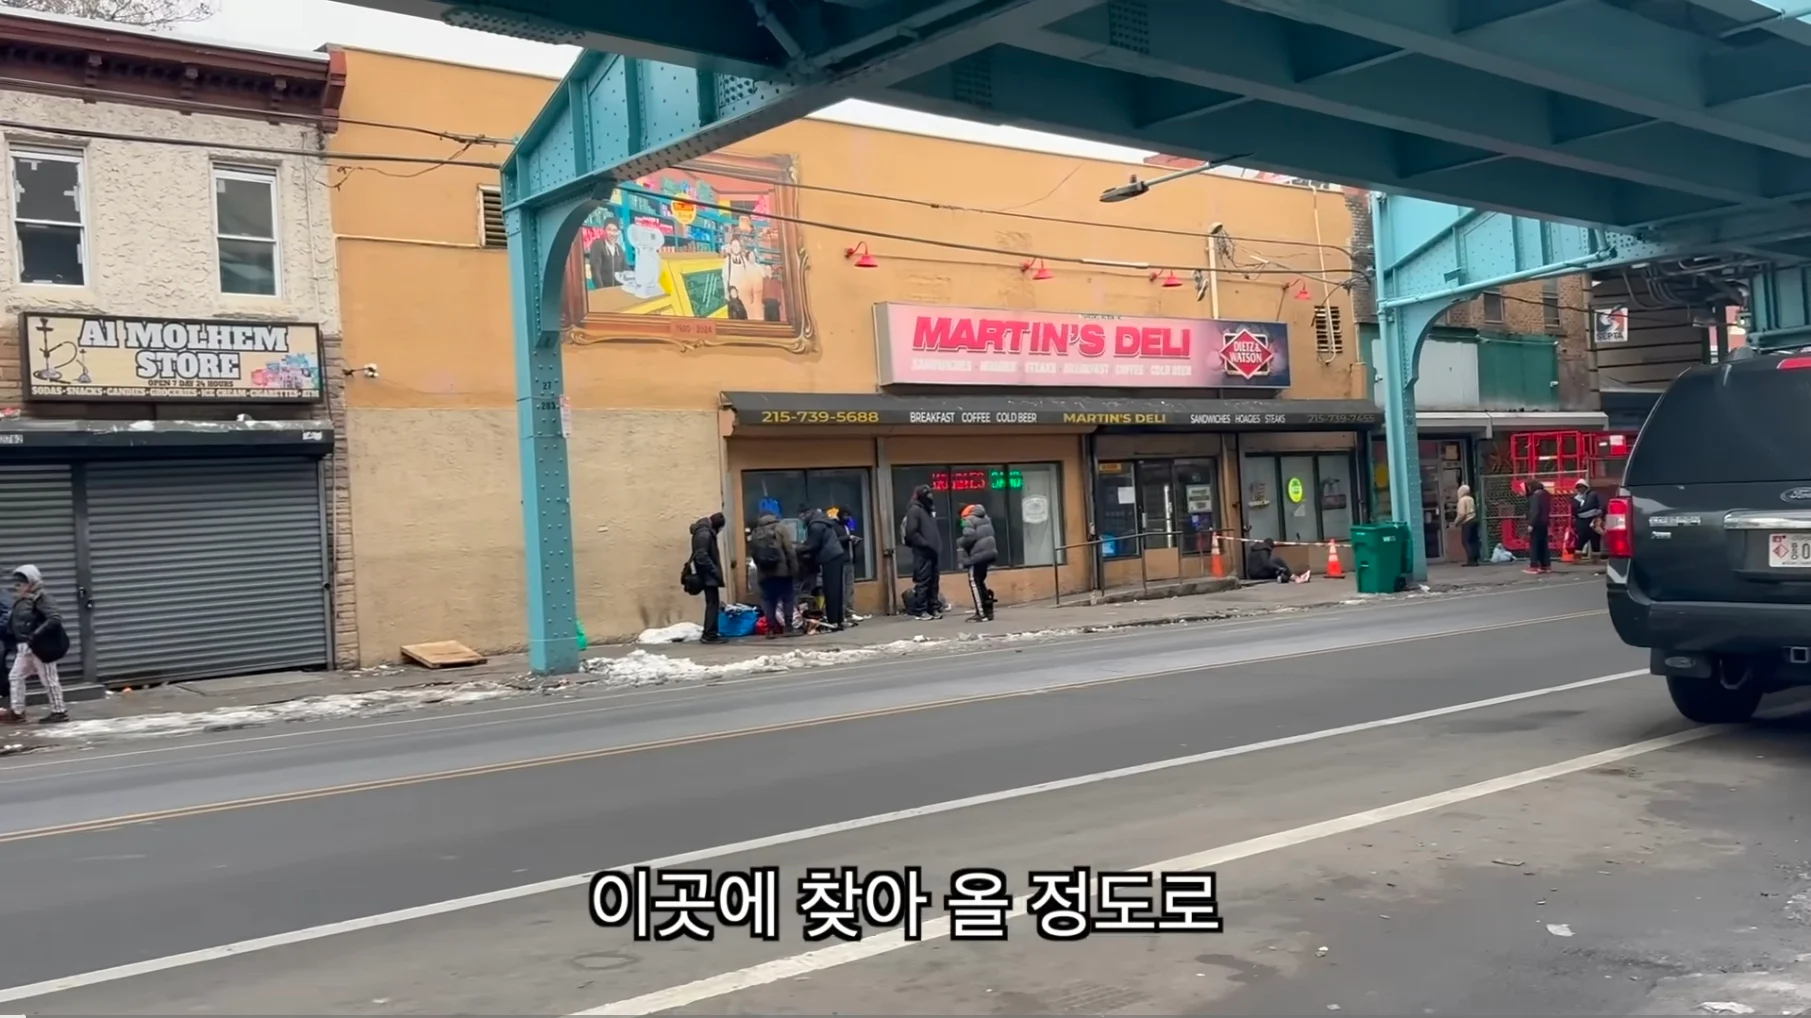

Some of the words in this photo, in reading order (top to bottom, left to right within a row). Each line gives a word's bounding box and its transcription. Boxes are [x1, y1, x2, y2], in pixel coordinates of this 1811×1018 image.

[125, 321, 289, 352] MOLHEM
[912, 316, 1105, 357] MARTIN'S
[1113, 325, 1191, 359] DELI
[1597, 332, 1624, 340] SEPTA
[1233, 341, 1255, 352] DIETZ
[1229, 351, 1263, 363] WATSON
[136, 350, 241, 379] STORE
[148, 379, 170, 387] OPEN
[196, 380, 207, 388] 24
[207, 380, 234, 388] HOURS
[31, 386, 61, 396] SODAS
[66, 387, 102, 396] SNACKS
[761, 411, 879, 423] 215-739-5688
[909, 411, 955, 423] BREAKFAST
[961, 412, 991, 423] COFFEE
[996, 412, 1017, 423] COLD
[1017, 412, 1037, 423] BEER
[1063, 413, 1131, 424] MARTIN'S
[1135, 413, 1166, 424] DELI
[1190, 414, 1231, 424] SANDWICHES
[1234, 414, 1260, 424] HOAGIES
[1264, 414, 1286, 424] STEAKS
